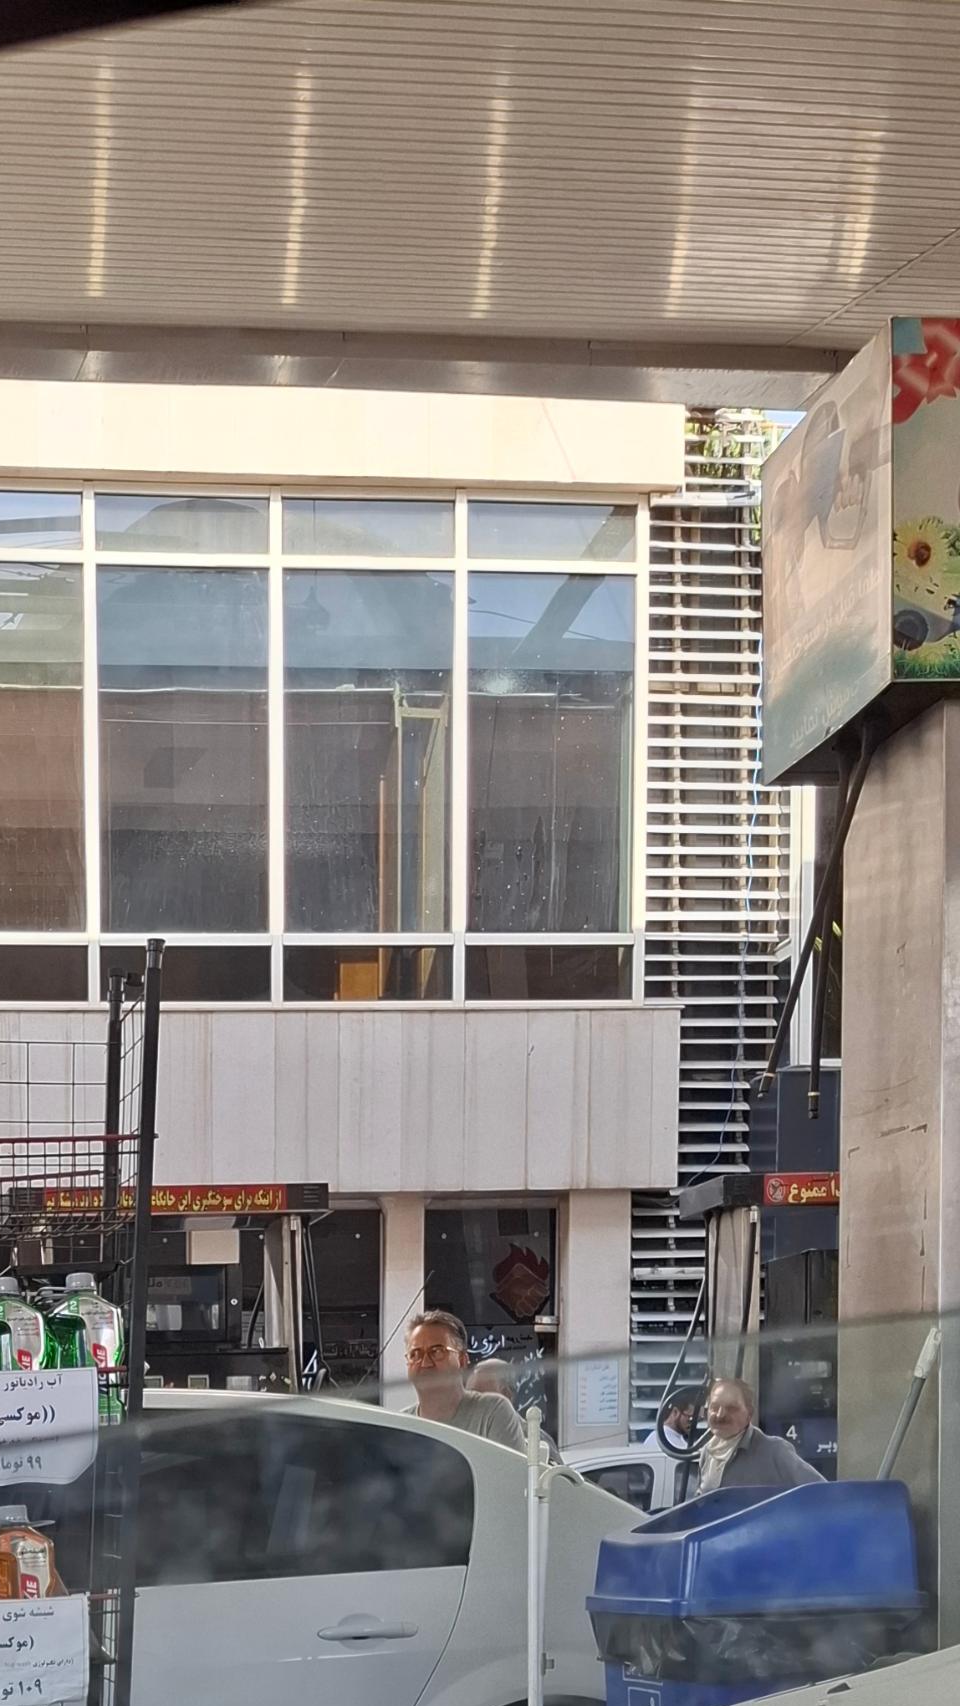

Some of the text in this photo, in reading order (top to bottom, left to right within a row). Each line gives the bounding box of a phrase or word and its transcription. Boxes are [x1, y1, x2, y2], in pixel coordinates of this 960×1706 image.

[178, 1190, 191, 1211] این
[234, 1190, 252, 1212] برای
[273, 1189, 282, 1211] از
[788, 1183, 827, 1204] ممنوع
[3, 1375, 44, 1392] رادیاتور
[46, 1374, 63, 1388] آب
[785, 1424, 798, 1440] 4
[26, 1455, 42, 1472] ۹۹
[2, 1608, 26, 1622] شوی
[29, 1605, 55, 1620] شیشه
[19, 1678, 43, 1695] ۱۰۹
